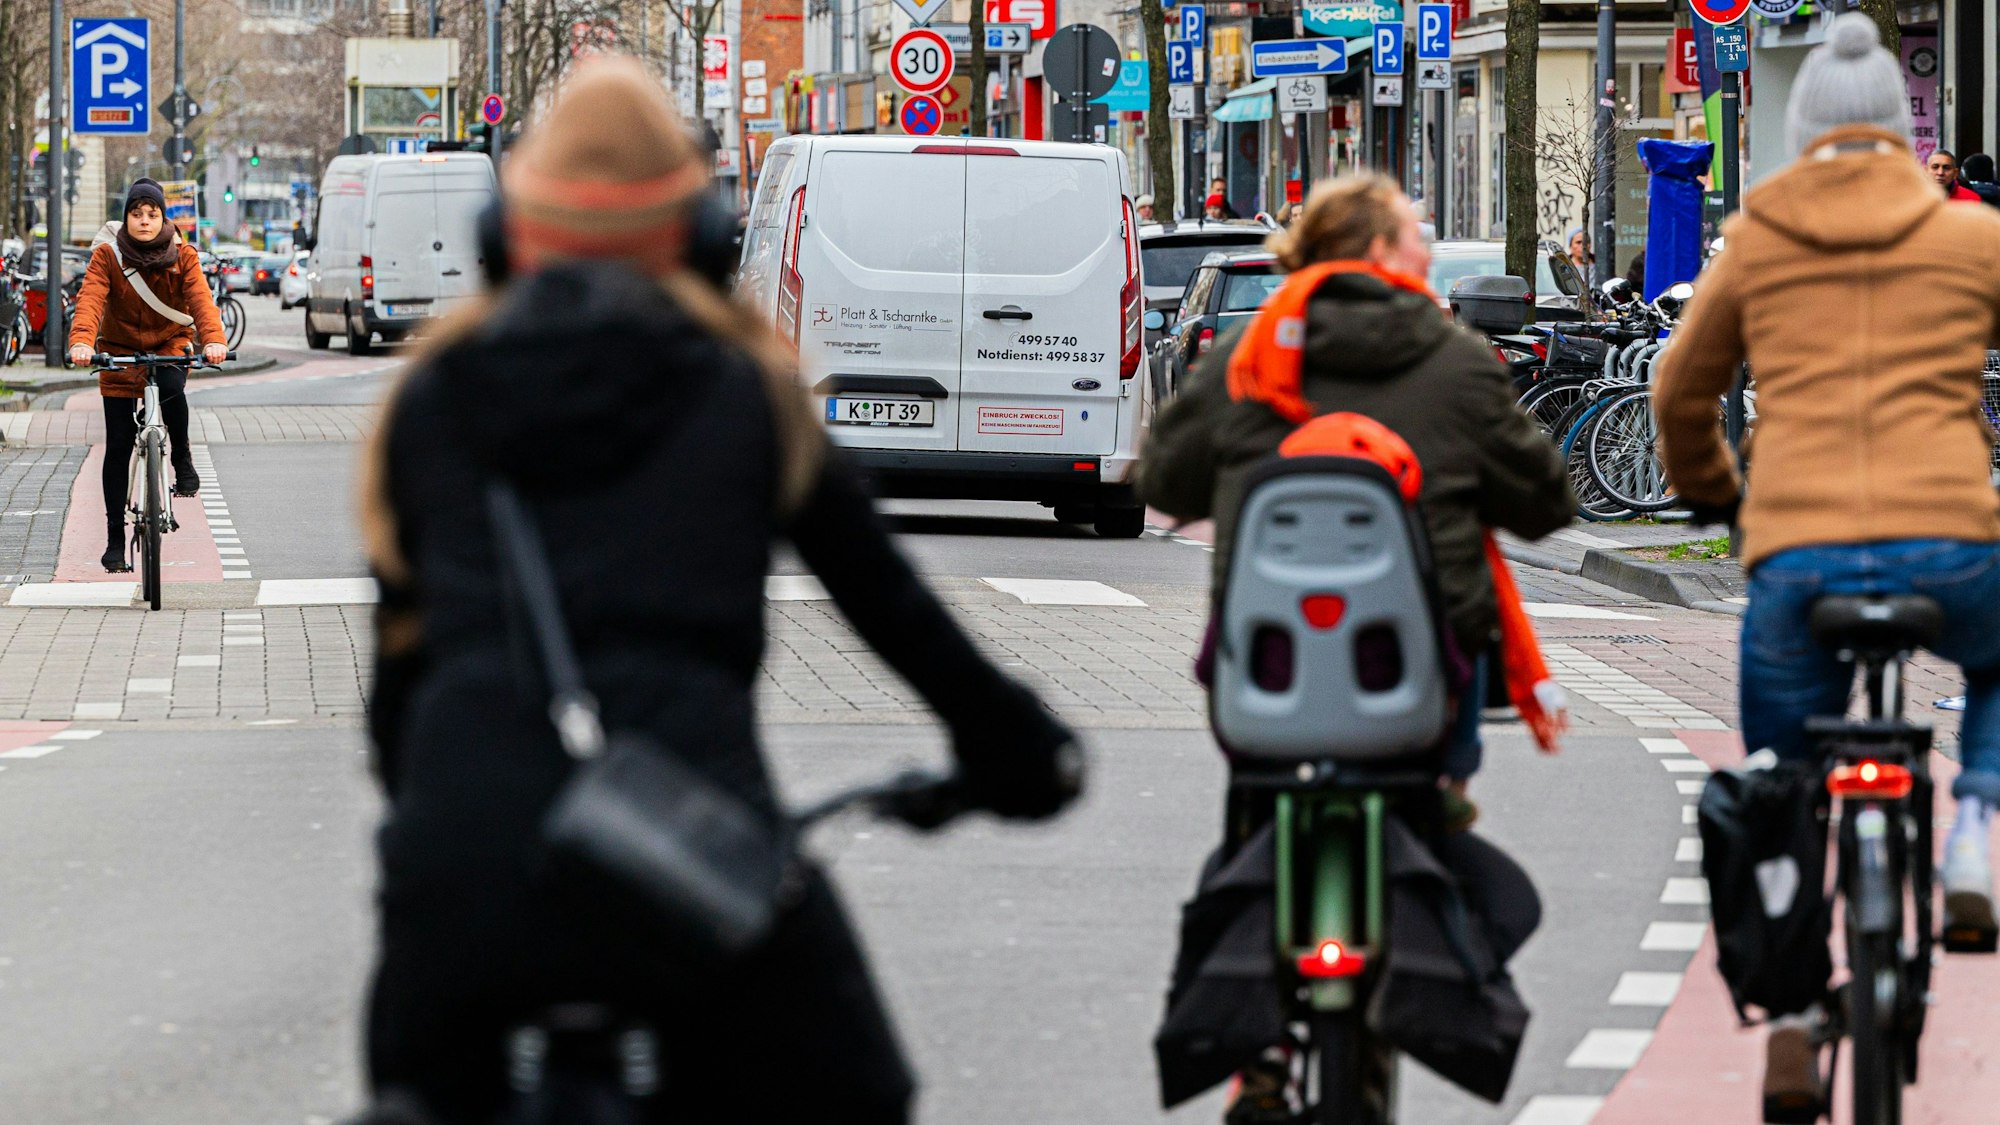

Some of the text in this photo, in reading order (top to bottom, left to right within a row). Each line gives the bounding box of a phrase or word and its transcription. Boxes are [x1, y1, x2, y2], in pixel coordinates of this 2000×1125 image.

[1422, 11, 1441, 52] P
[904, 48, 938, 74] 30
[1258, 53, 1319, 64] Einbahnstraße
[1377, 28, 1395, 68] P
[91, 43, 129, 98] P
[1171, 45, 1186, 79] P
[841, 308, 865, 320] Platt
[869, 309, 878, 320] &
[882, 310, 937, 323] Tscharntke
[977, 349, 1043, 361] Notdienst:
[849, 402, 920, 420] K PT 39
